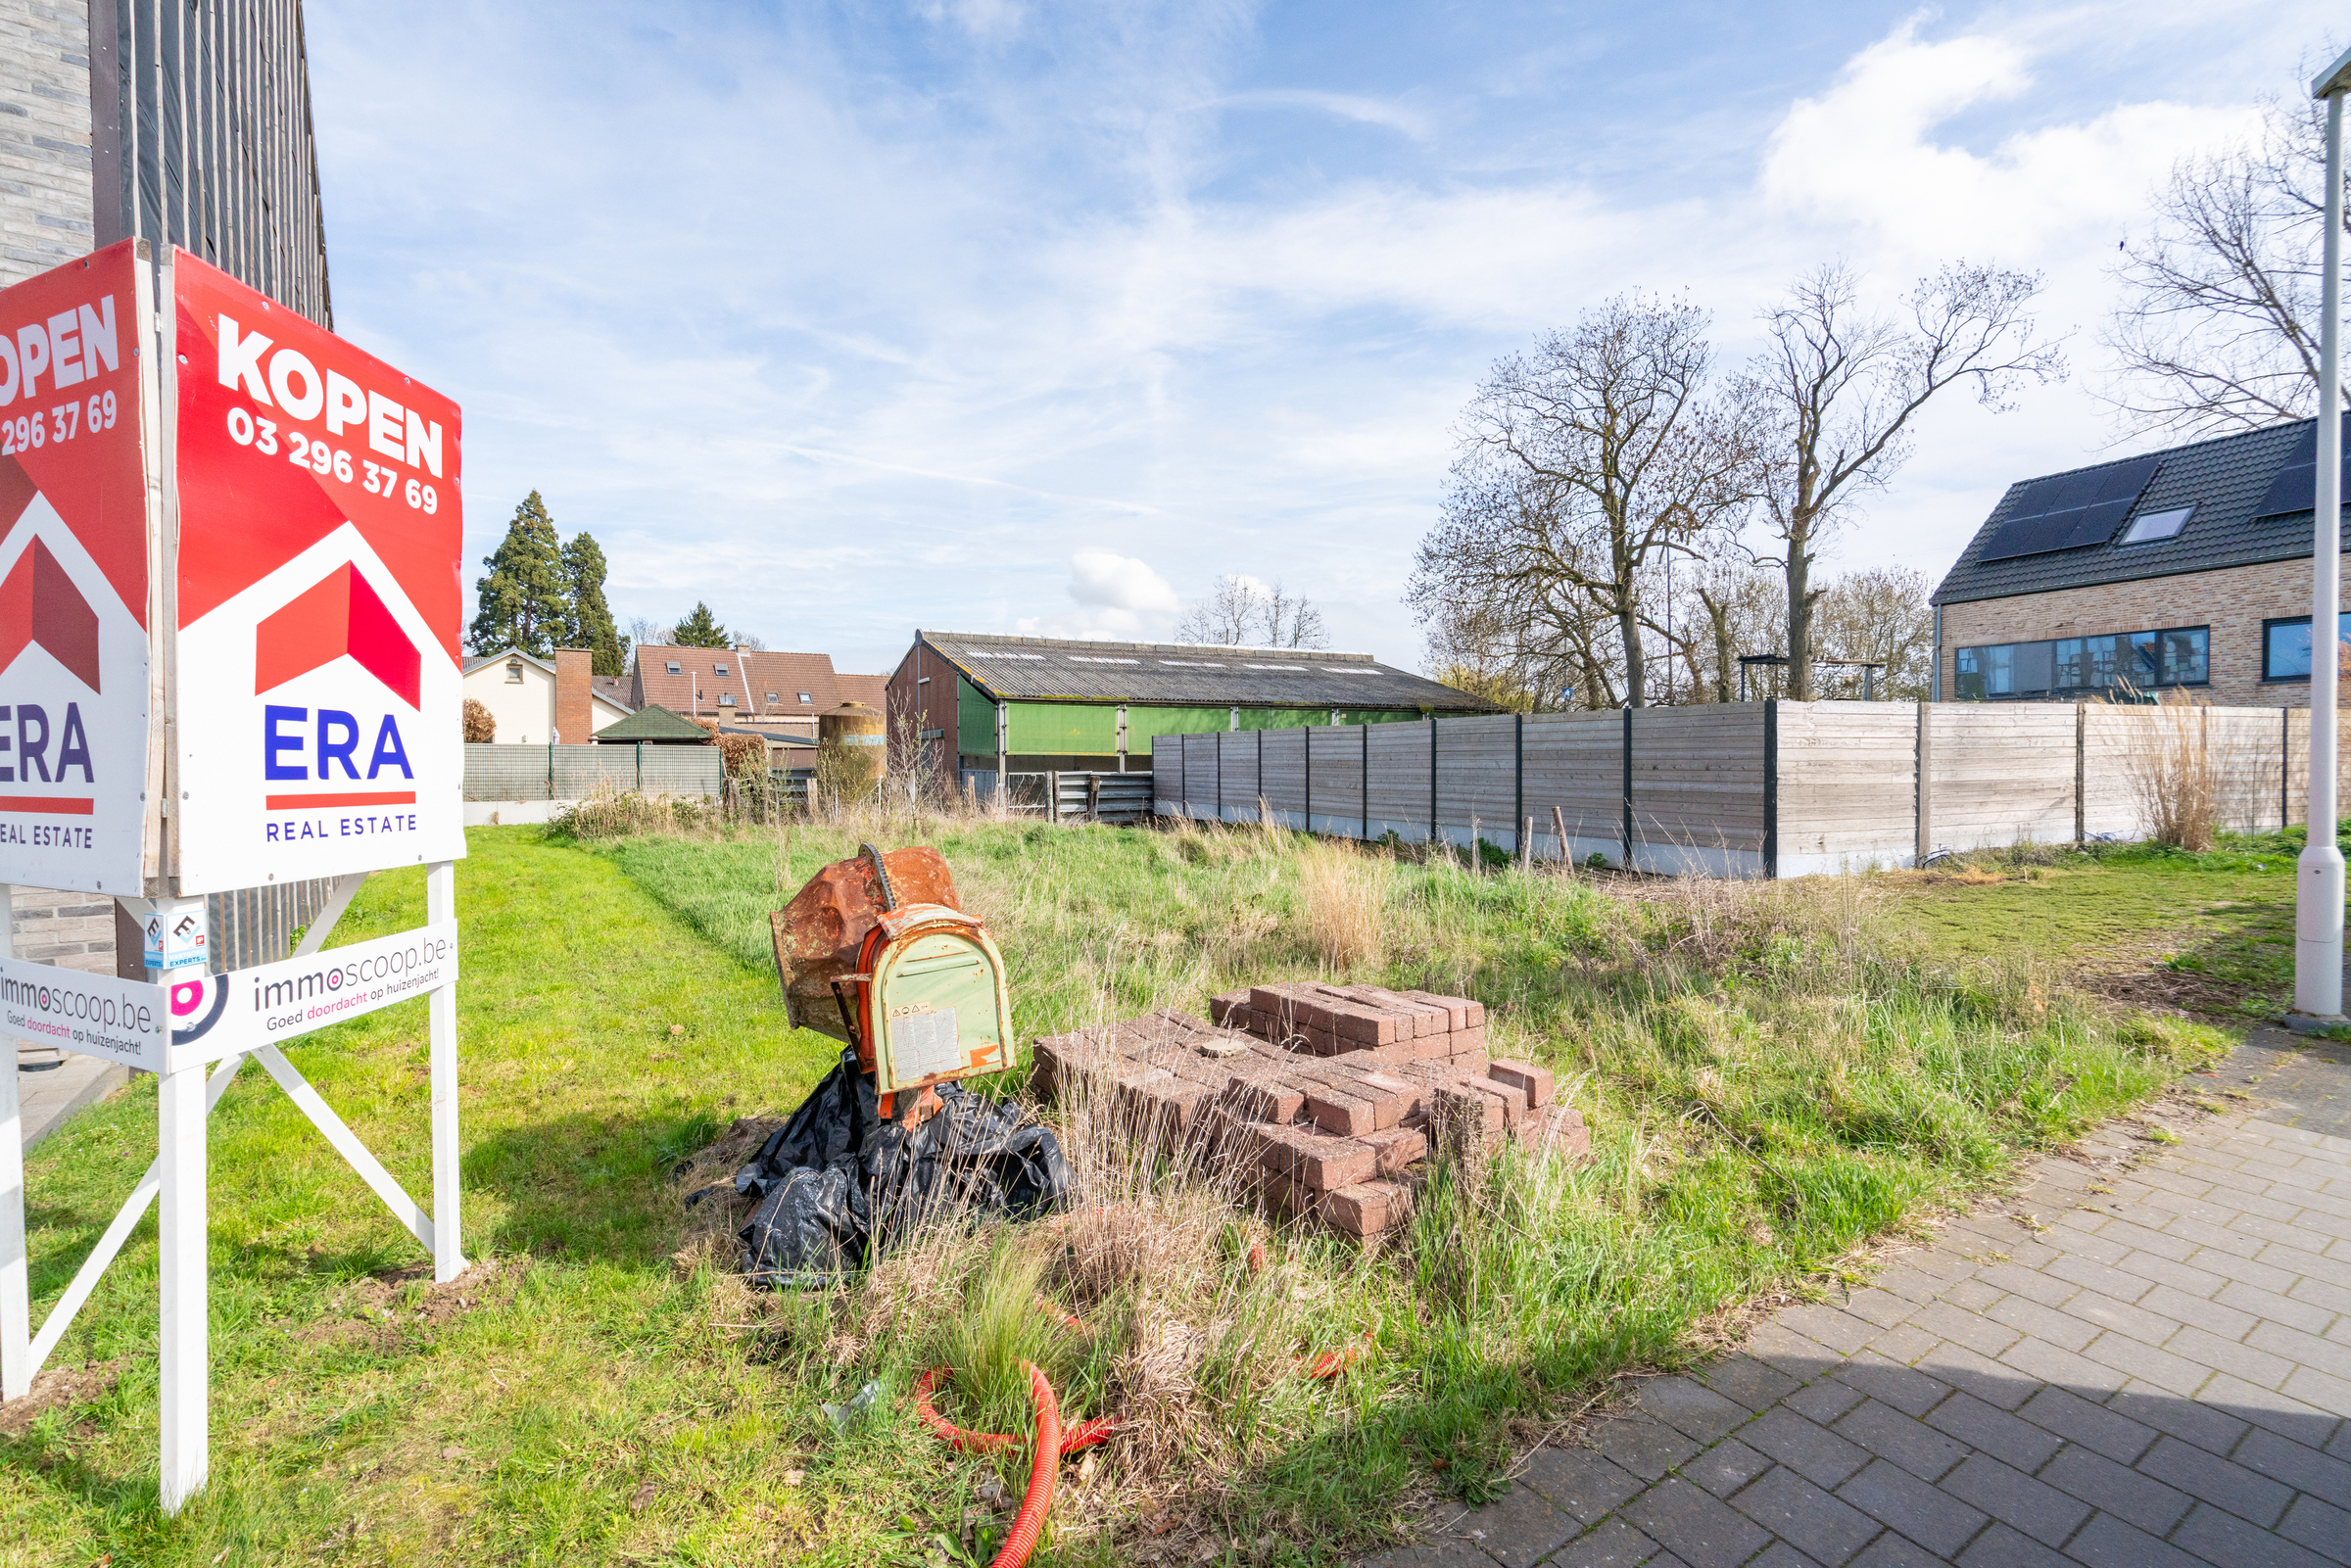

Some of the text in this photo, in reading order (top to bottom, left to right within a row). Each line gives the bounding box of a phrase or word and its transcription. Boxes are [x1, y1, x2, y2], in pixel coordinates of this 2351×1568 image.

[1, 390, 118, 456] 296 37 69
[218, 312, 443, 479] KOPEN
[227, 406, 438, 515] 03 296 37 69
[264, 704, 414, 781] ERA
[33, 826, 93, 849] ESTATE
[266, 814, 416, 842] REAL ESTATE
[0, 967, 151, 1033] immoscoop.be
[254, 937, 447, 1012] immoscoop.be
[266, 968, 440, 1031] Goed doordacht op huizenjacht!
[7, 1010, 141, 1056] Goed doordacht op huizenjacht!
